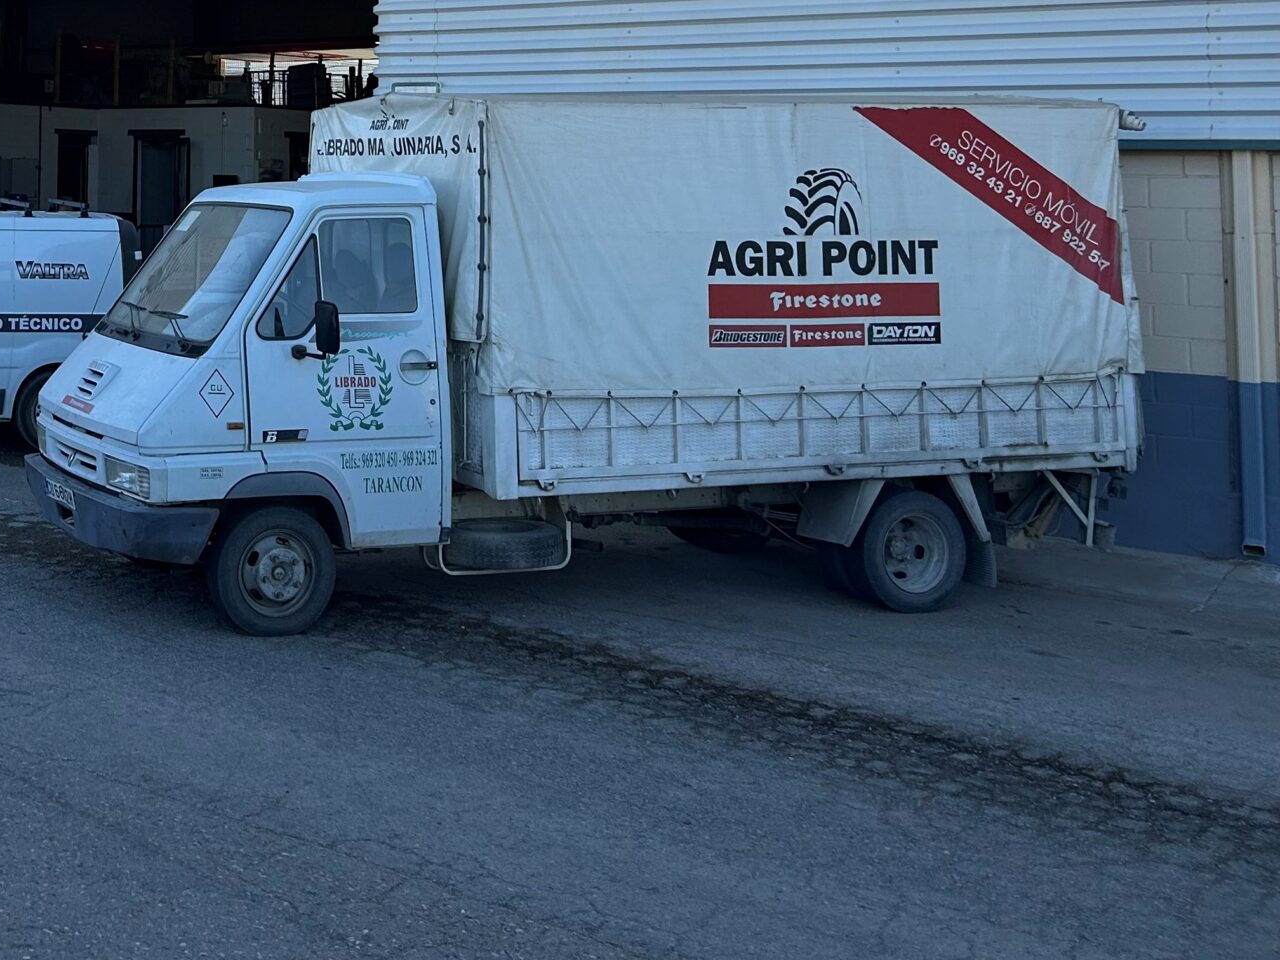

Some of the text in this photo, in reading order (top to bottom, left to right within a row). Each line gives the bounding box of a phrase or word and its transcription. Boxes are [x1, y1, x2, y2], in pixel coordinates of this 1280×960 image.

[368, 135, 448, 158] MAUINARIA,
[957, 130, 1099, 246] SERVICIO MÓVIL
[939, 142, 966, 166] 969
[966, 162, 986, 181] 32
[986, 177, 1005, 194] 43
[1004, 189, 1023, 208] 21
[1034, 211, 1062, 234] 687
[1062, 229, 1087, 256] 922
[707, 239, 939, 277] AGRI POINT
[15, 260, 89, 280] VALTRA
[769, 290, 883, 313] Firestone
[8, 314, 83, 331] TÉCNICO
[872, 325, 936, 338] DAYTON
[711, 329, 785, 343] BRIDGESTONE
[792, 329, 863, 342] Firestone
[210, 384, 223, 392] CU
[335, 377, 377, 388] LIBRADO
[361, 453, 373, 468] 969
[374, 452, 385, 468] 320
[386, 452, 397, 467] 450
[403, 450, 414, 466] 969
[415, 450, 426, 466] 324
[427, 449, 437, 466] 321
[363, 475, 423, 494] TARANCON
